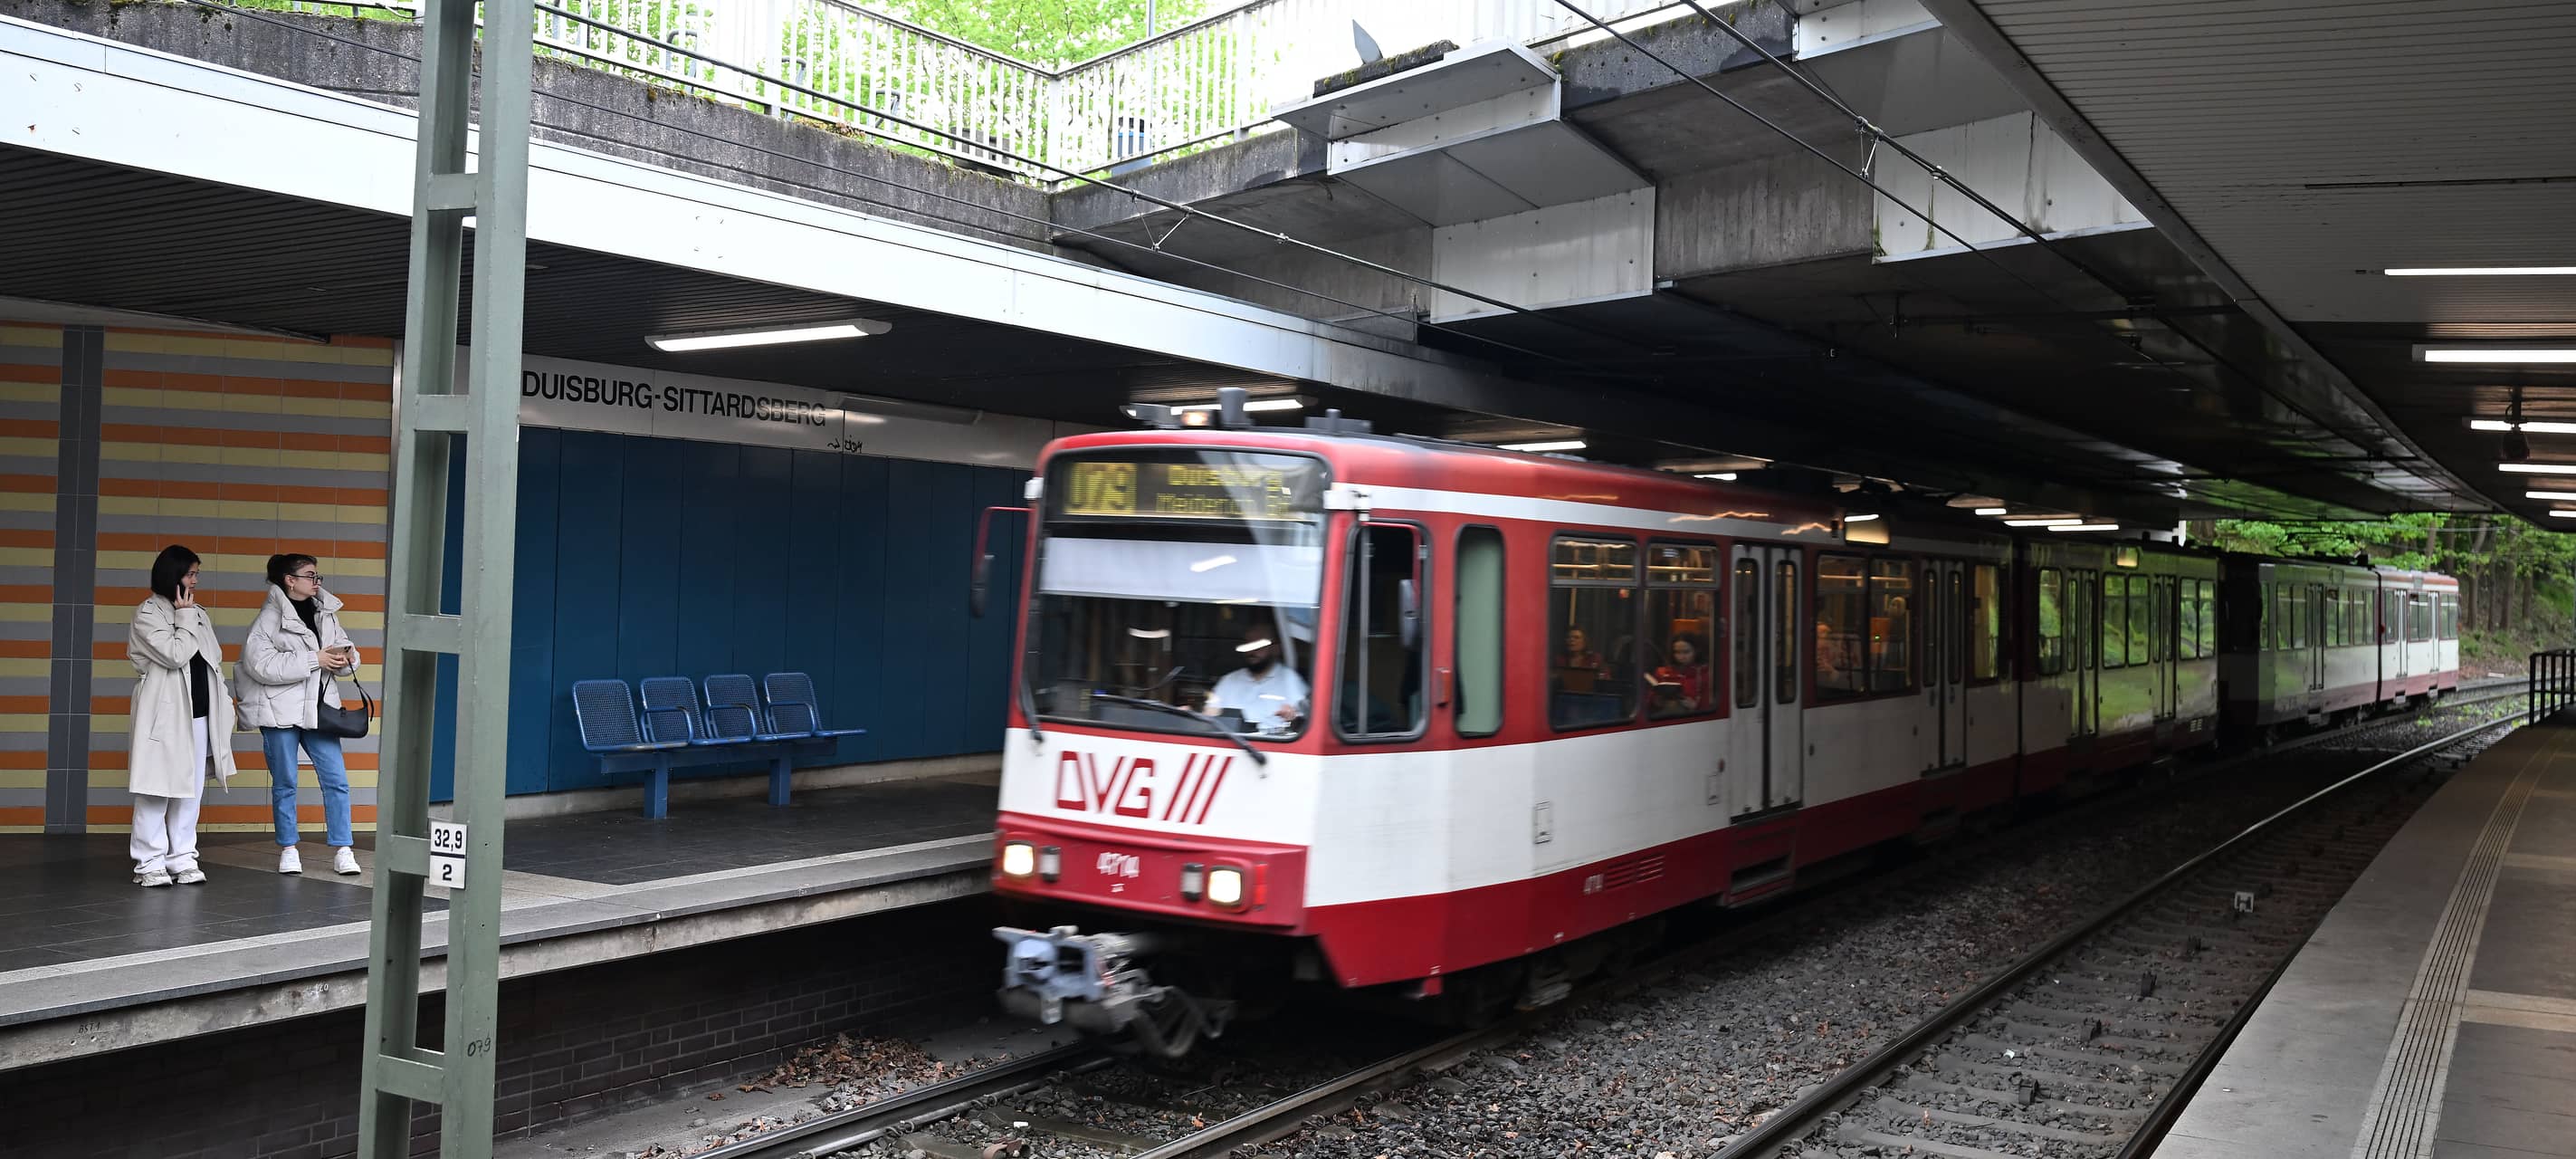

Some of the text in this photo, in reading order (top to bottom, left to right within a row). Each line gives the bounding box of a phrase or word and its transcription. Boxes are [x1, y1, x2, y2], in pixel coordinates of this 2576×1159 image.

[521, 370, 826, 426] DUISBURG-SITTARDSBERG
[1055, 751, 1155, 819] DVG
[434, 829, 463, 852] 32,9
[442, 864, 453, 882] 2
